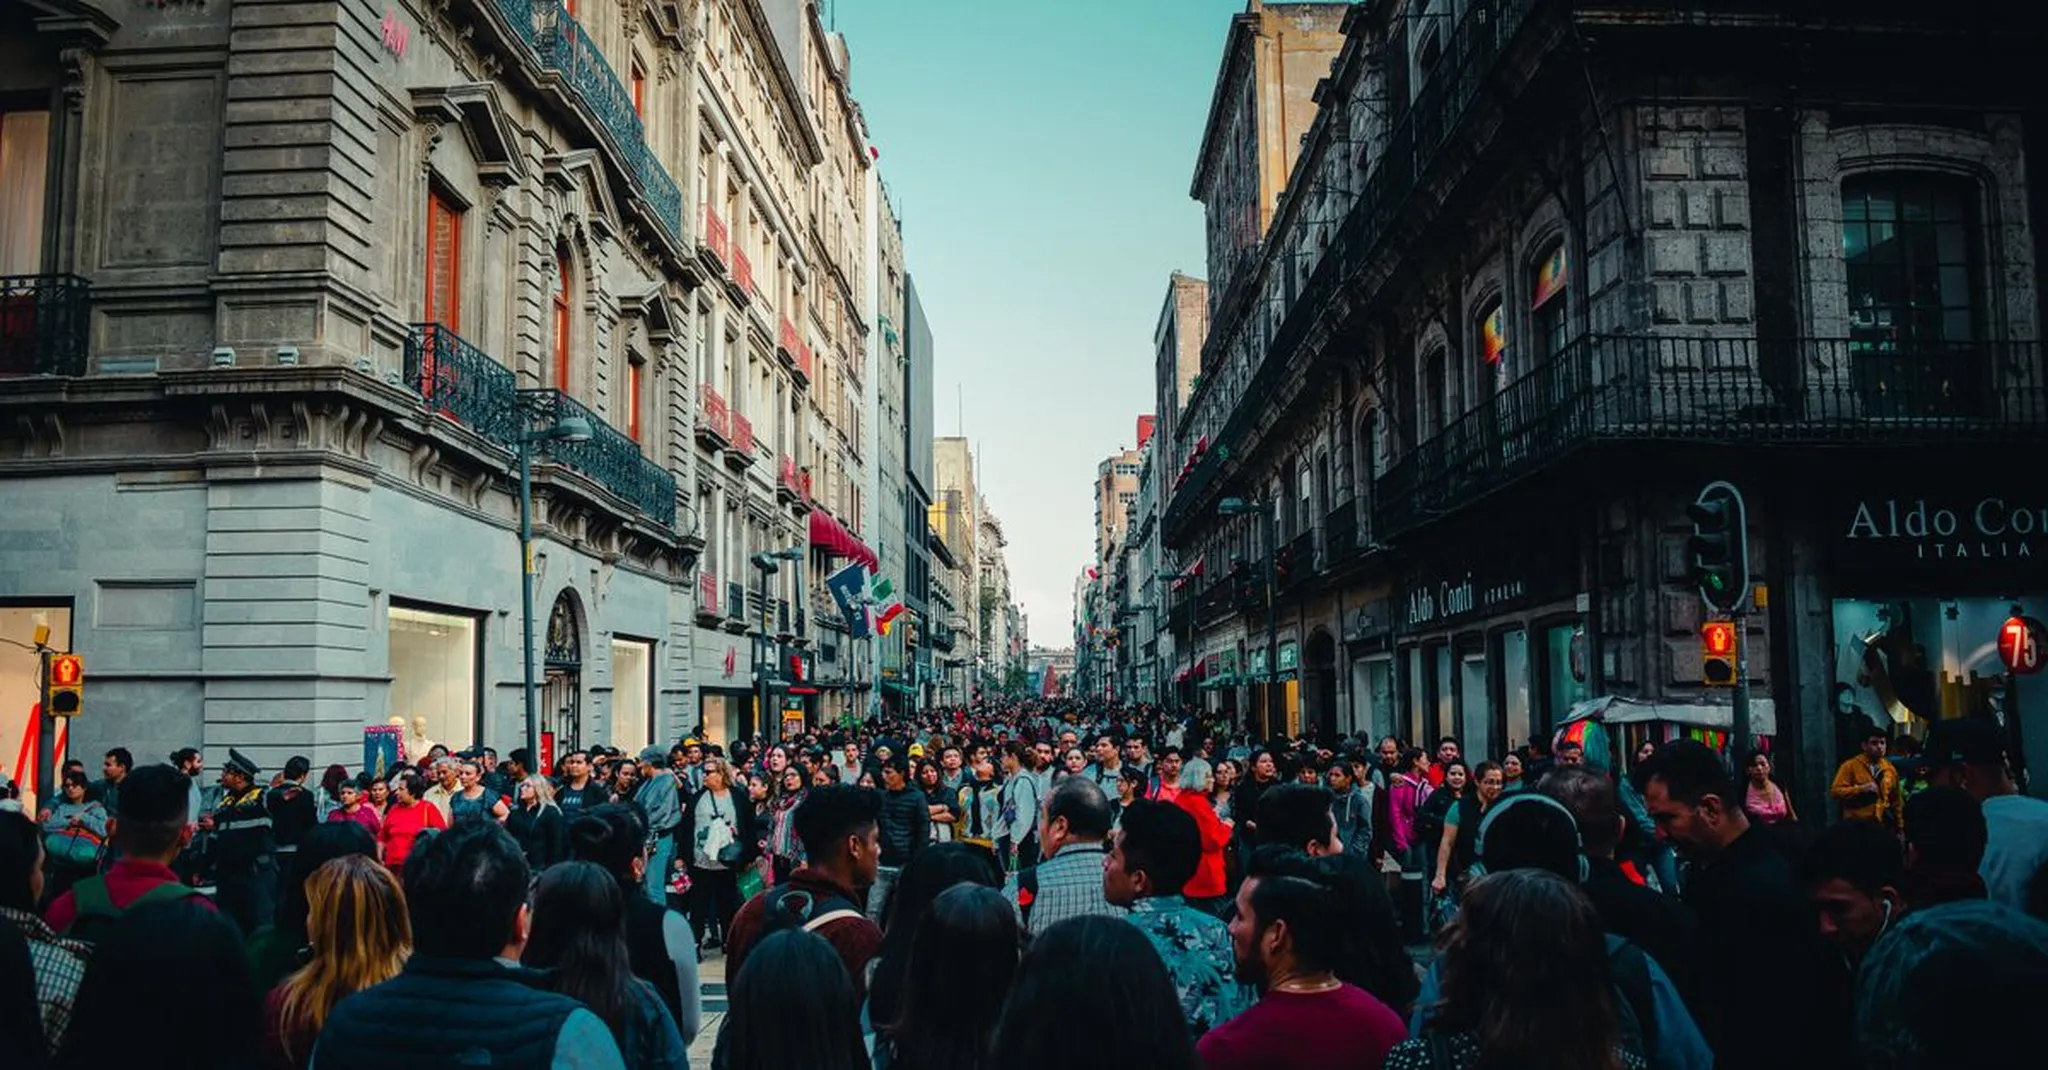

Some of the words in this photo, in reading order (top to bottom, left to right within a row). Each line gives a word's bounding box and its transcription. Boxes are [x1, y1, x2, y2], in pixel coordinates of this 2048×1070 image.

[1846, 499, 1956, 538] Aldo
[1917, 542, 2030, 559] ITALIA
[1409, 586, 1434, 624] Aldo
[1440, 571, 1473, 617] Conti
[2006, 626, 2037, 668] 75
